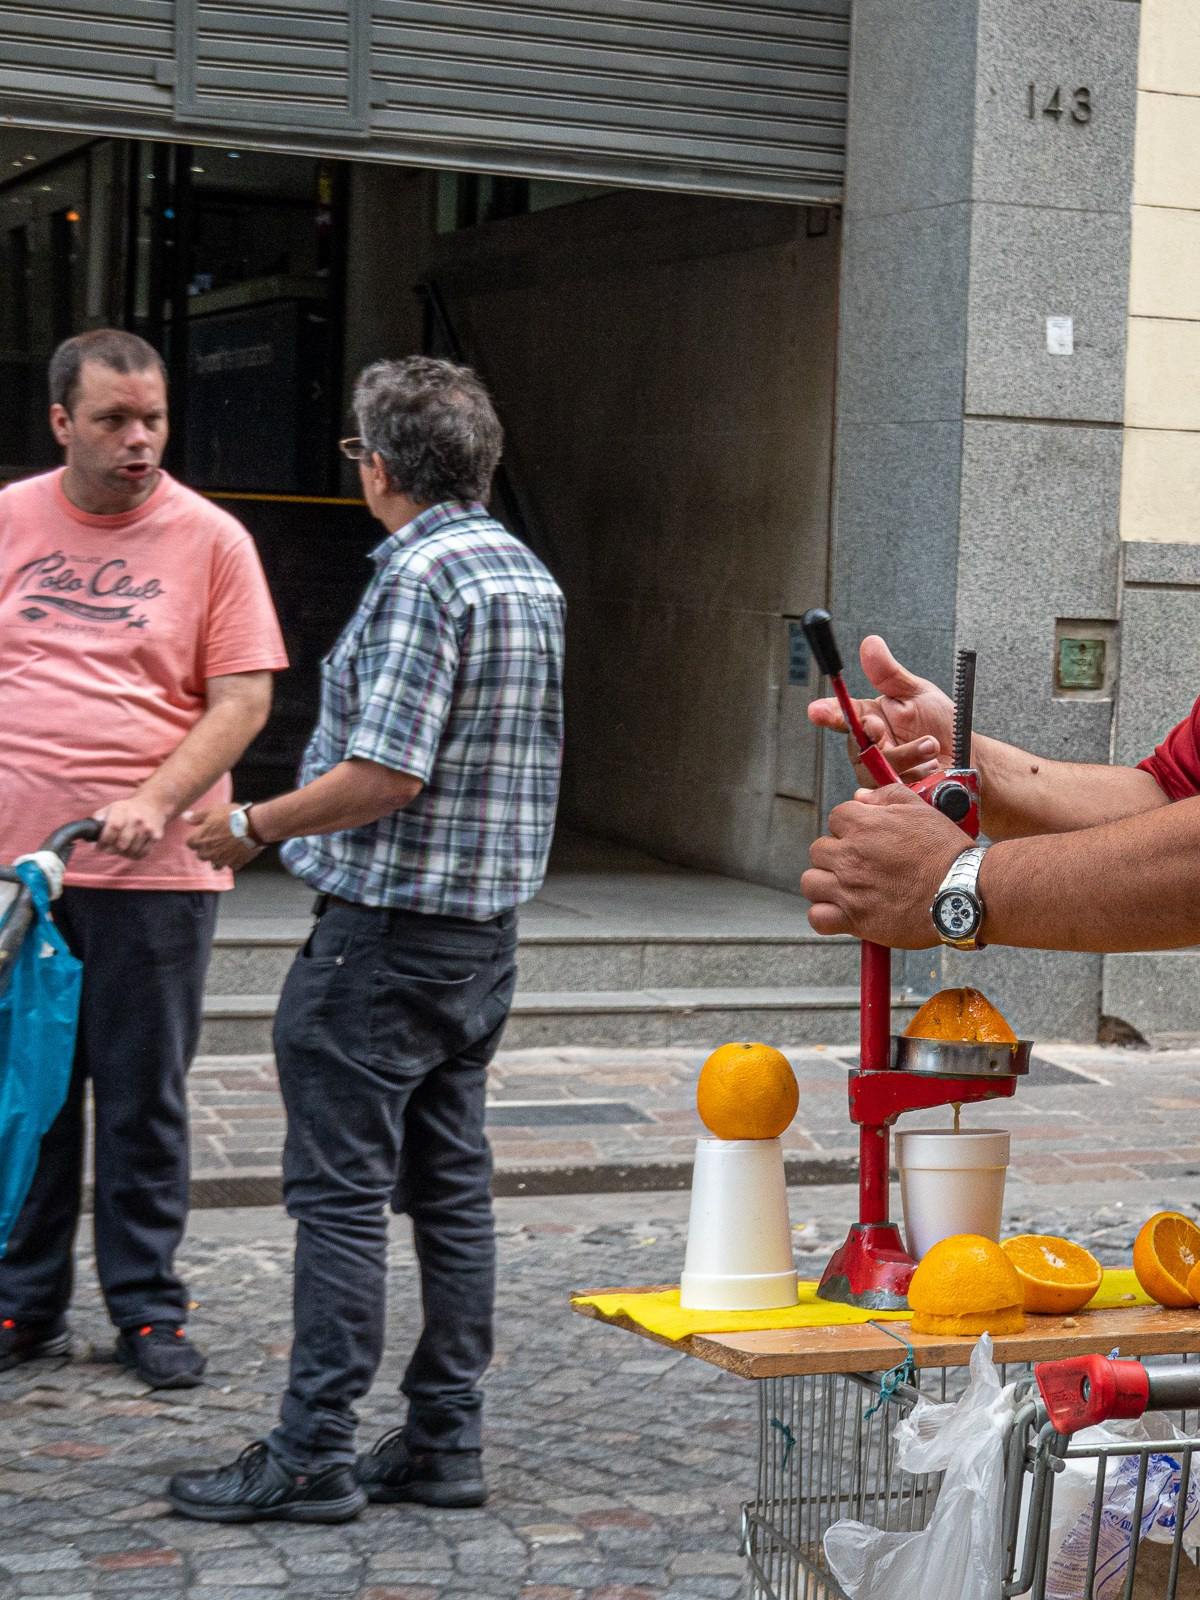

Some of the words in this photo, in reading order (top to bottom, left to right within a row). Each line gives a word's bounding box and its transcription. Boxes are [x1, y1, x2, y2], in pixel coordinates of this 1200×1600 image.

[1027, 81, 1092, 124] 143
[16, 550, 84, 594] Polo
[87, 559, 166, 599] Club
